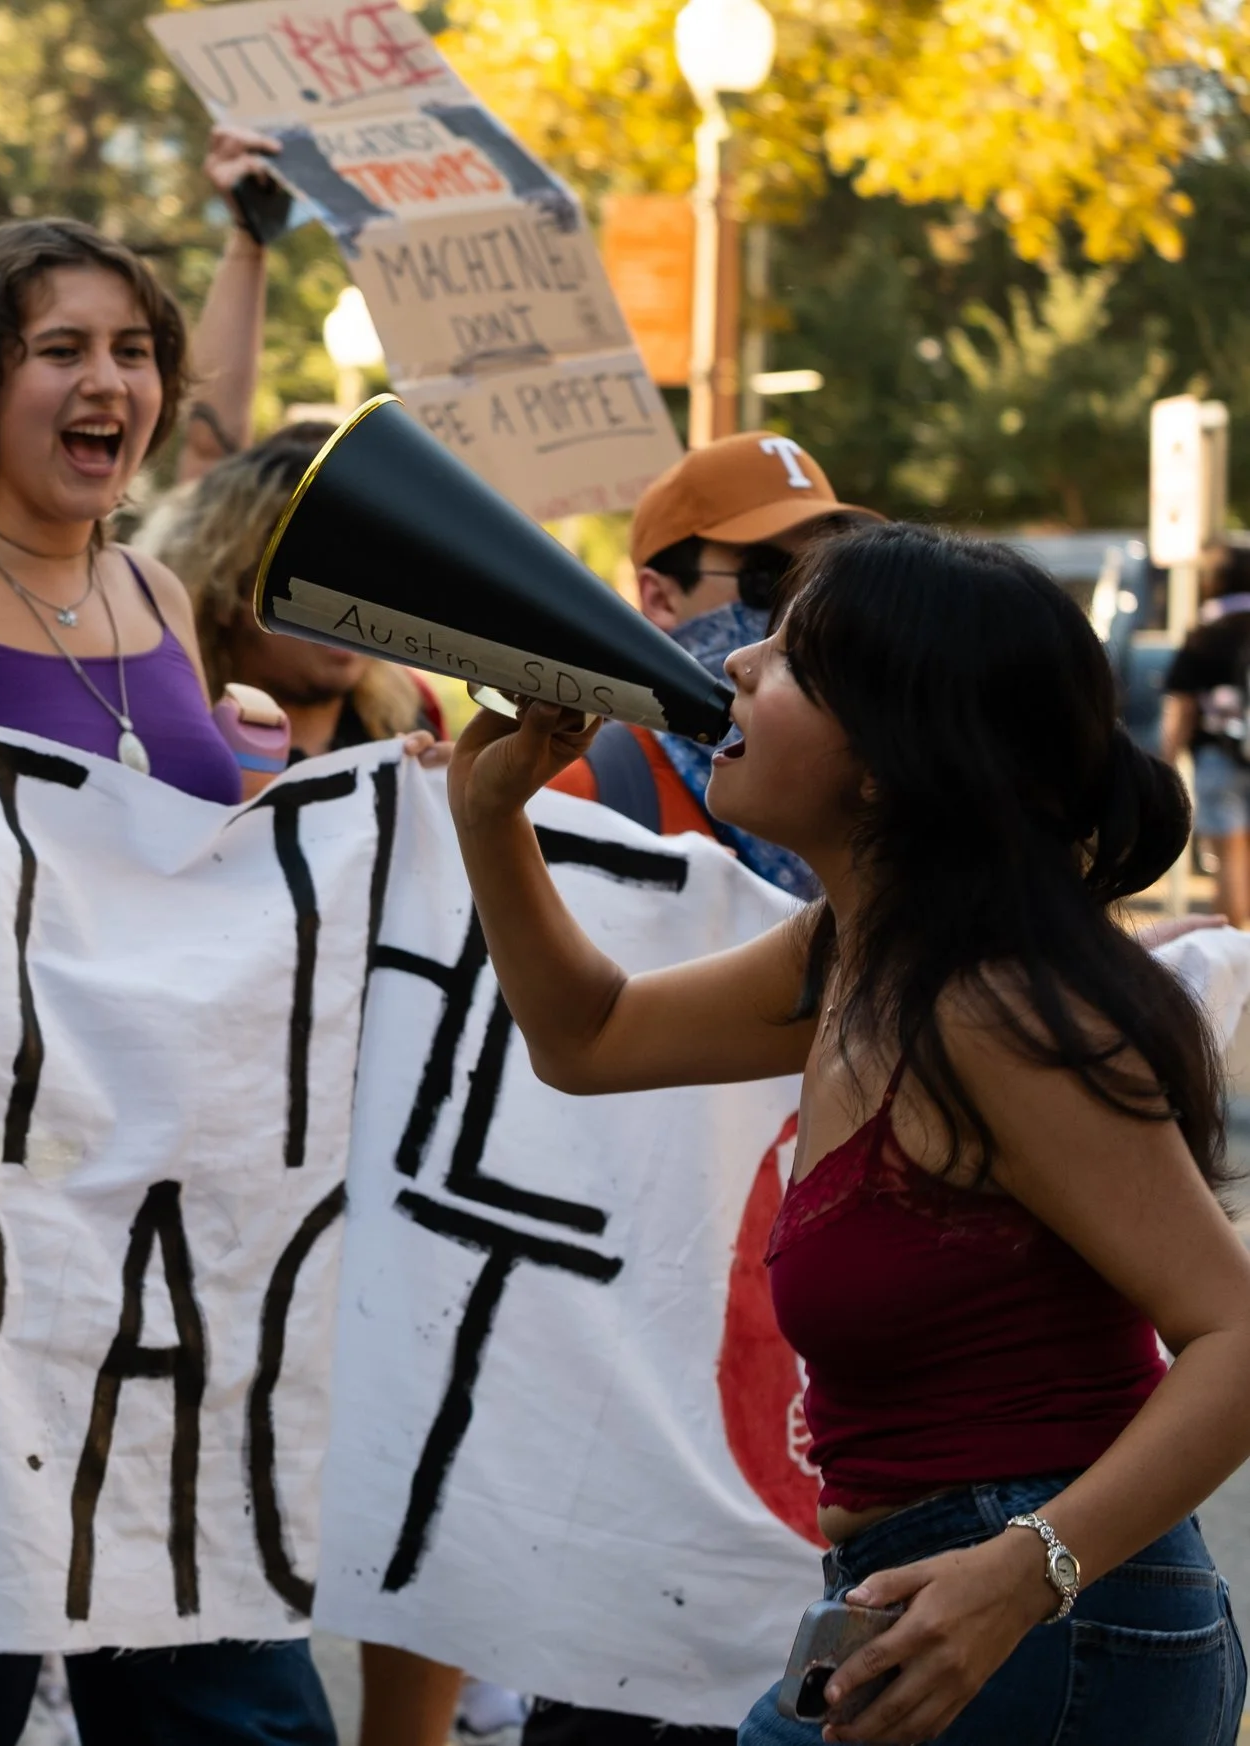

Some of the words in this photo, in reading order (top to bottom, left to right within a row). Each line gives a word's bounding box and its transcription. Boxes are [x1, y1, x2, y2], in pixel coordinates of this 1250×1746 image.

[489, 394, 517, 436] A
[759, 437, 812, 488] T
[517, 660, 615, 716] SDS
[226, 761, 689, 1235] THE
